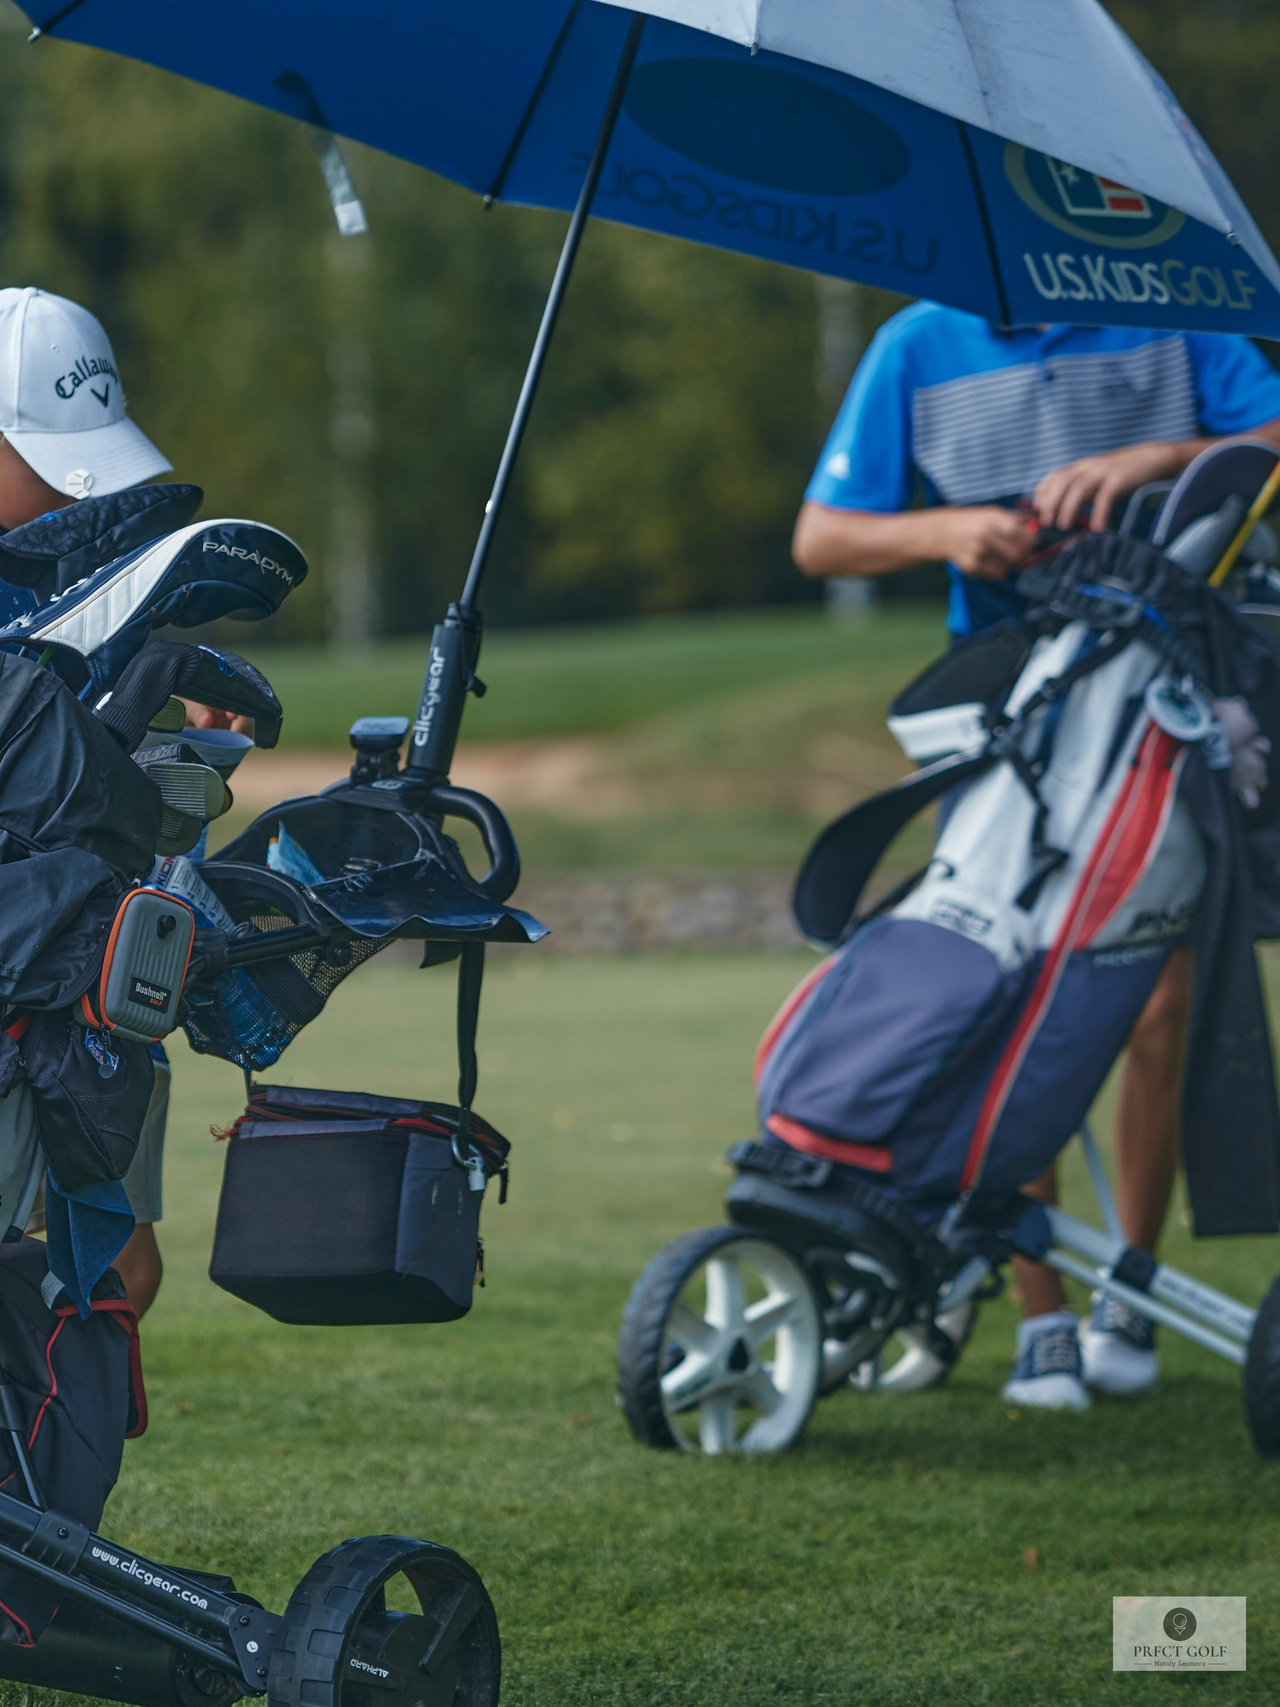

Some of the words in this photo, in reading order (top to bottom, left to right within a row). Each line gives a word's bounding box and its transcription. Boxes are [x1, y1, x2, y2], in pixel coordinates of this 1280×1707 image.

[55, 355, 118, 399] Callaway
[202, 541, 293, 585] PARADYM
[412, 646, 446, 747] clicgear
[199, 901, 206, 909] 3
[135, 982, 165, 1001] Bushnell
[91, 1546, 209, 1610] www.clicgear.com
[350, 1658, 389, 1678] ALPHARD
